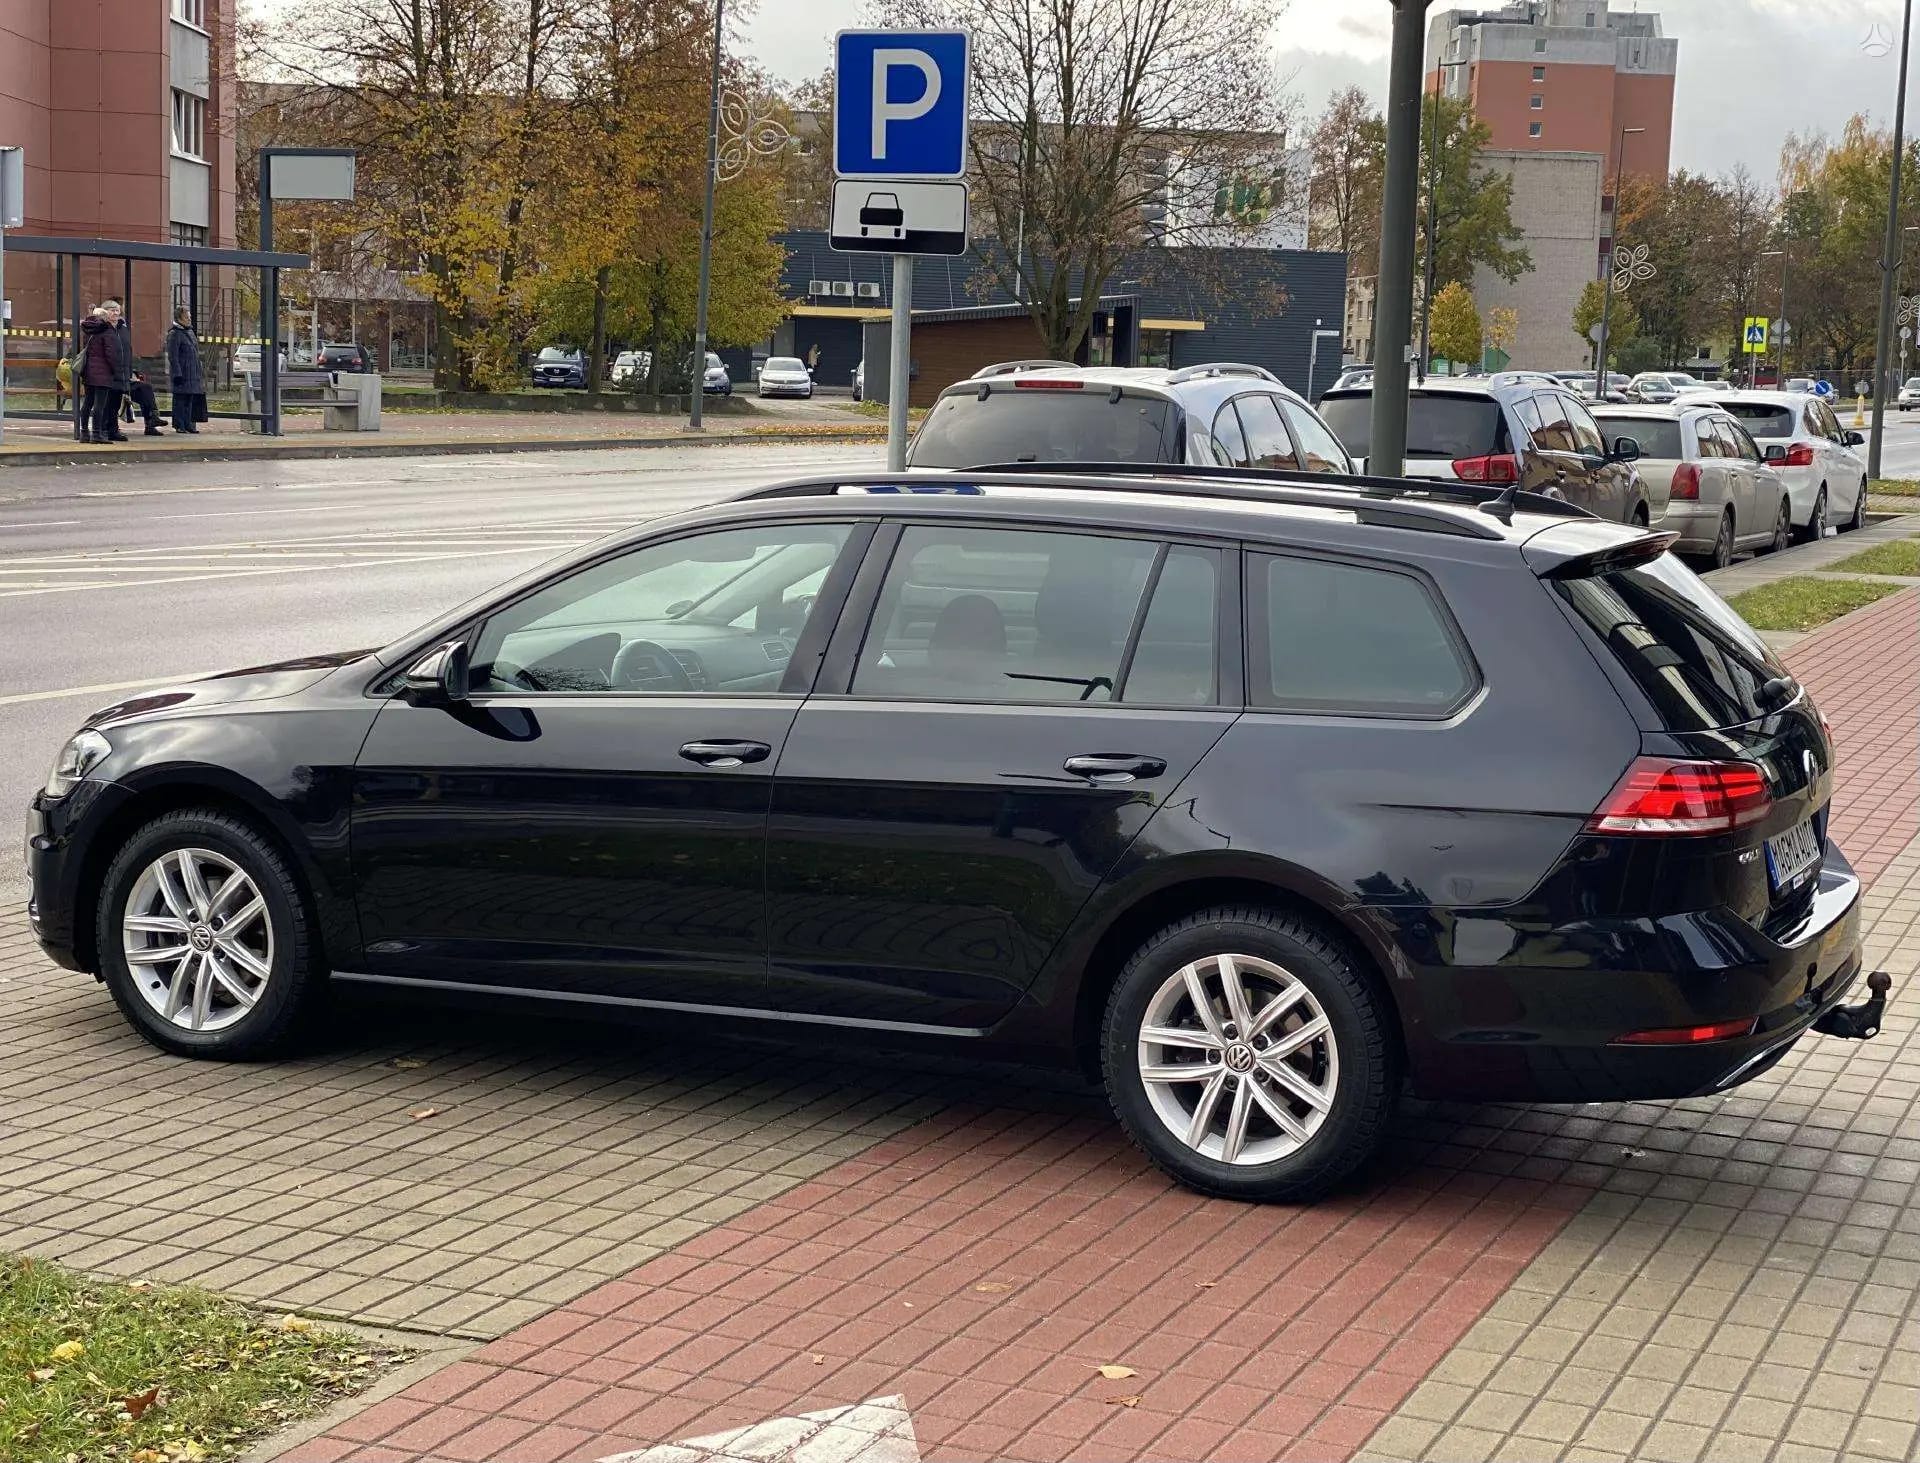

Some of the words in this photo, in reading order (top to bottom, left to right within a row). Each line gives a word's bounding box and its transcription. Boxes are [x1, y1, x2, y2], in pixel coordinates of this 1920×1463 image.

[872, 48, 942, 159] P
[1770, 831, 1801, 877] MAGMA
[1795, 819, 1818, 861] AUTO
